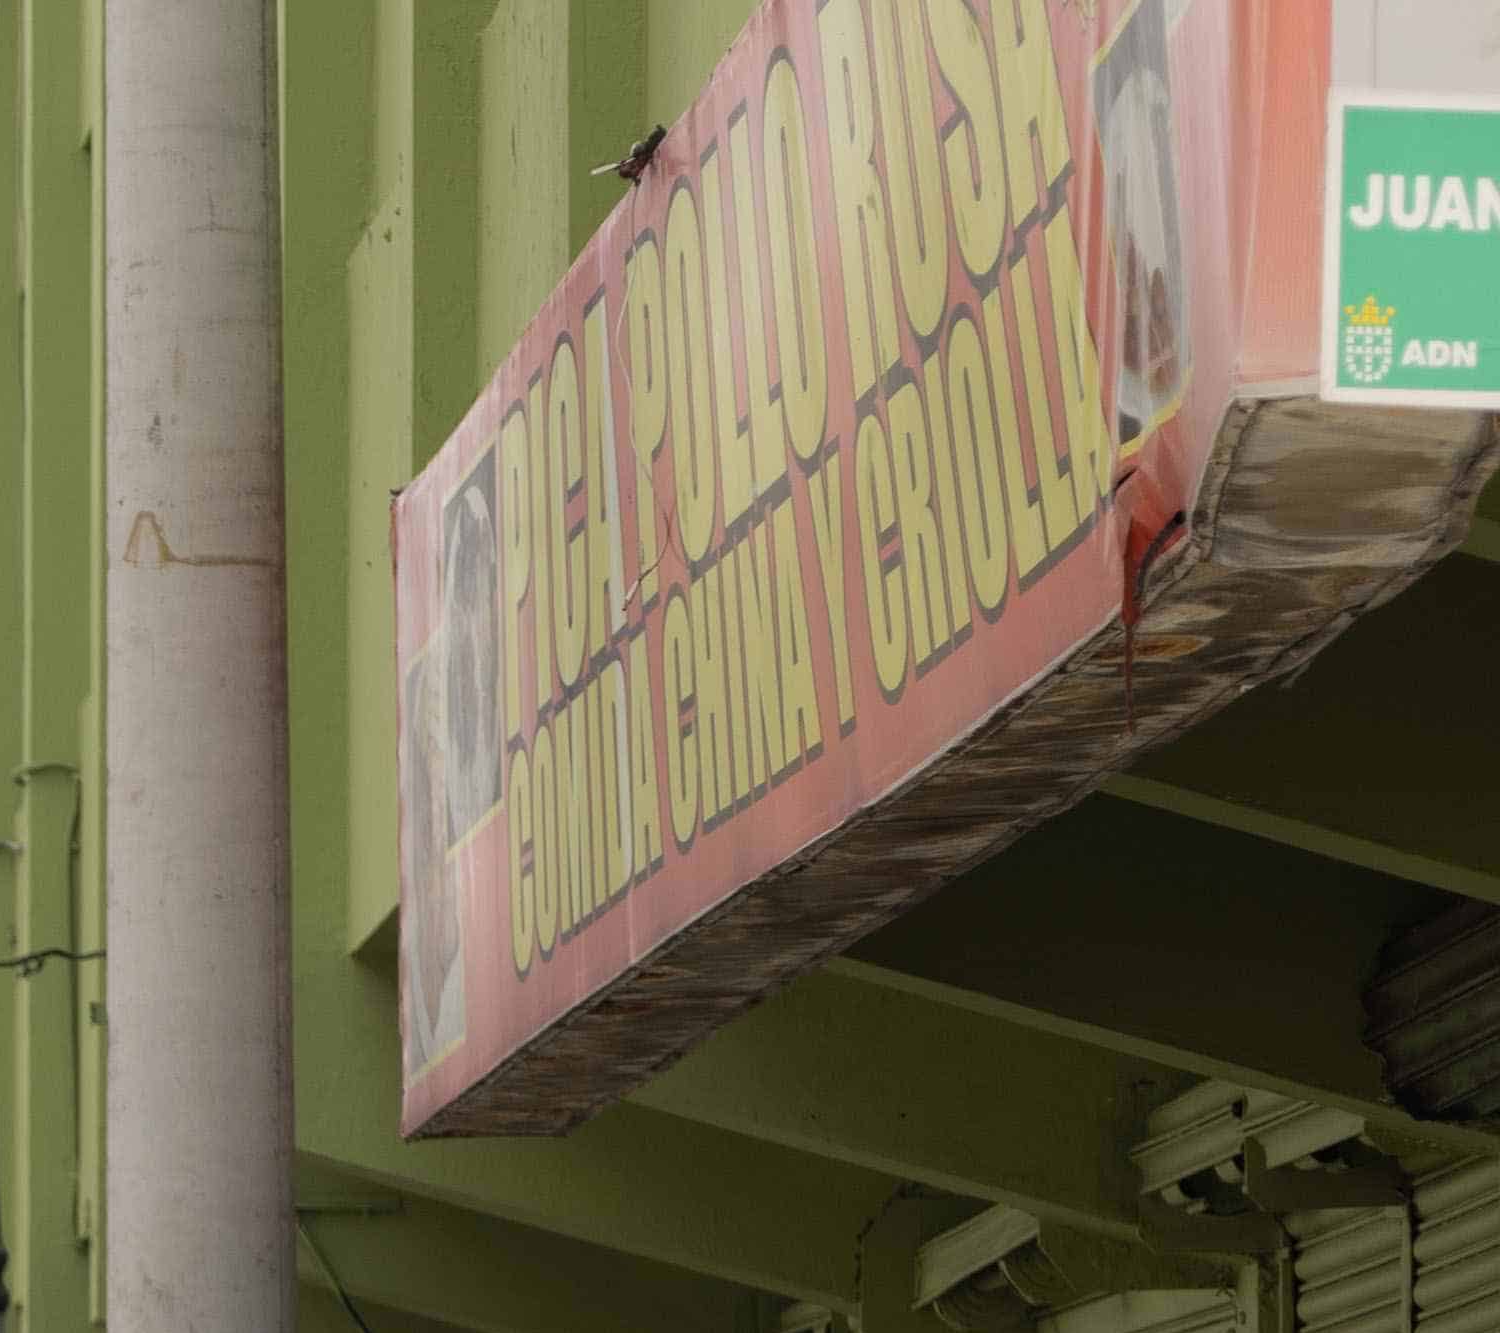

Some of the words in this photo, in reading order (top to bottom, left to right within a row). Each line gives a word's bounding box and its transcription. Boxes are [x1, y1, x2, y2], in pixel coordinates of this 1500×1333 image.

[1348, 172, 1500, 231] JUAN
[1401, 339, 1478, 368] ADN
[499, 285, 631, 755] PICA
[618, 42, 828, 612] POLLO
[508, 612, 666, 986] COMIDA
[660, 485, 826, 856] CHINA
[804, 435, 857, 742] Y
[852, 200, 1114, 708] CRIOLLA
